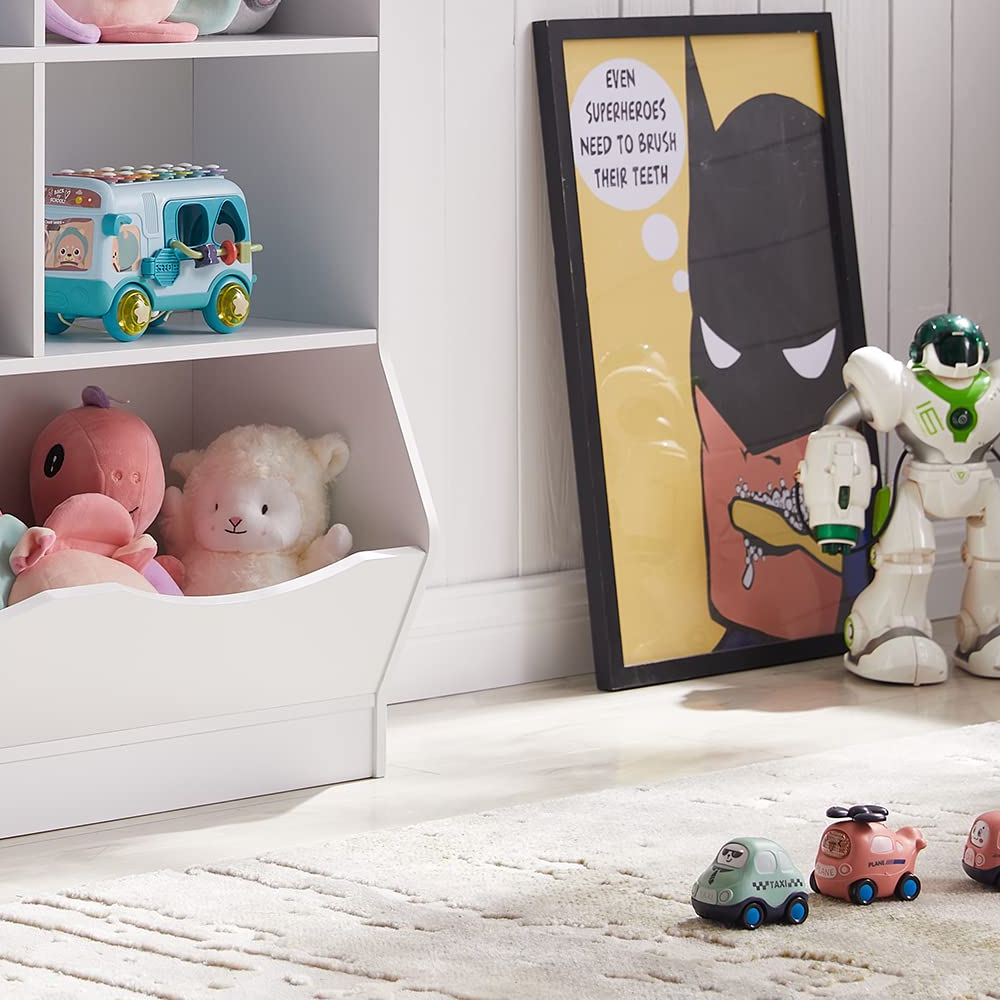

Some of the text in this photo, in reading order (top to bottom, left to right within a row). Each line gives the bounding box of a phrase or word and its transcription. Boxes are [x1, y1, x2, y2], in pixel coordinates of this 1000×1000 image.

[606, 68, 636, 89] EVEN
[585, 97, 667, 124] SUPERHEROES
[580, 131, 677, 156] NEED TO BRUSH
[594, 164, 668, 189] THEIR TEETH
[156, 263, 179, 272] STOP
[769, 880, 787, 889] TAXI
